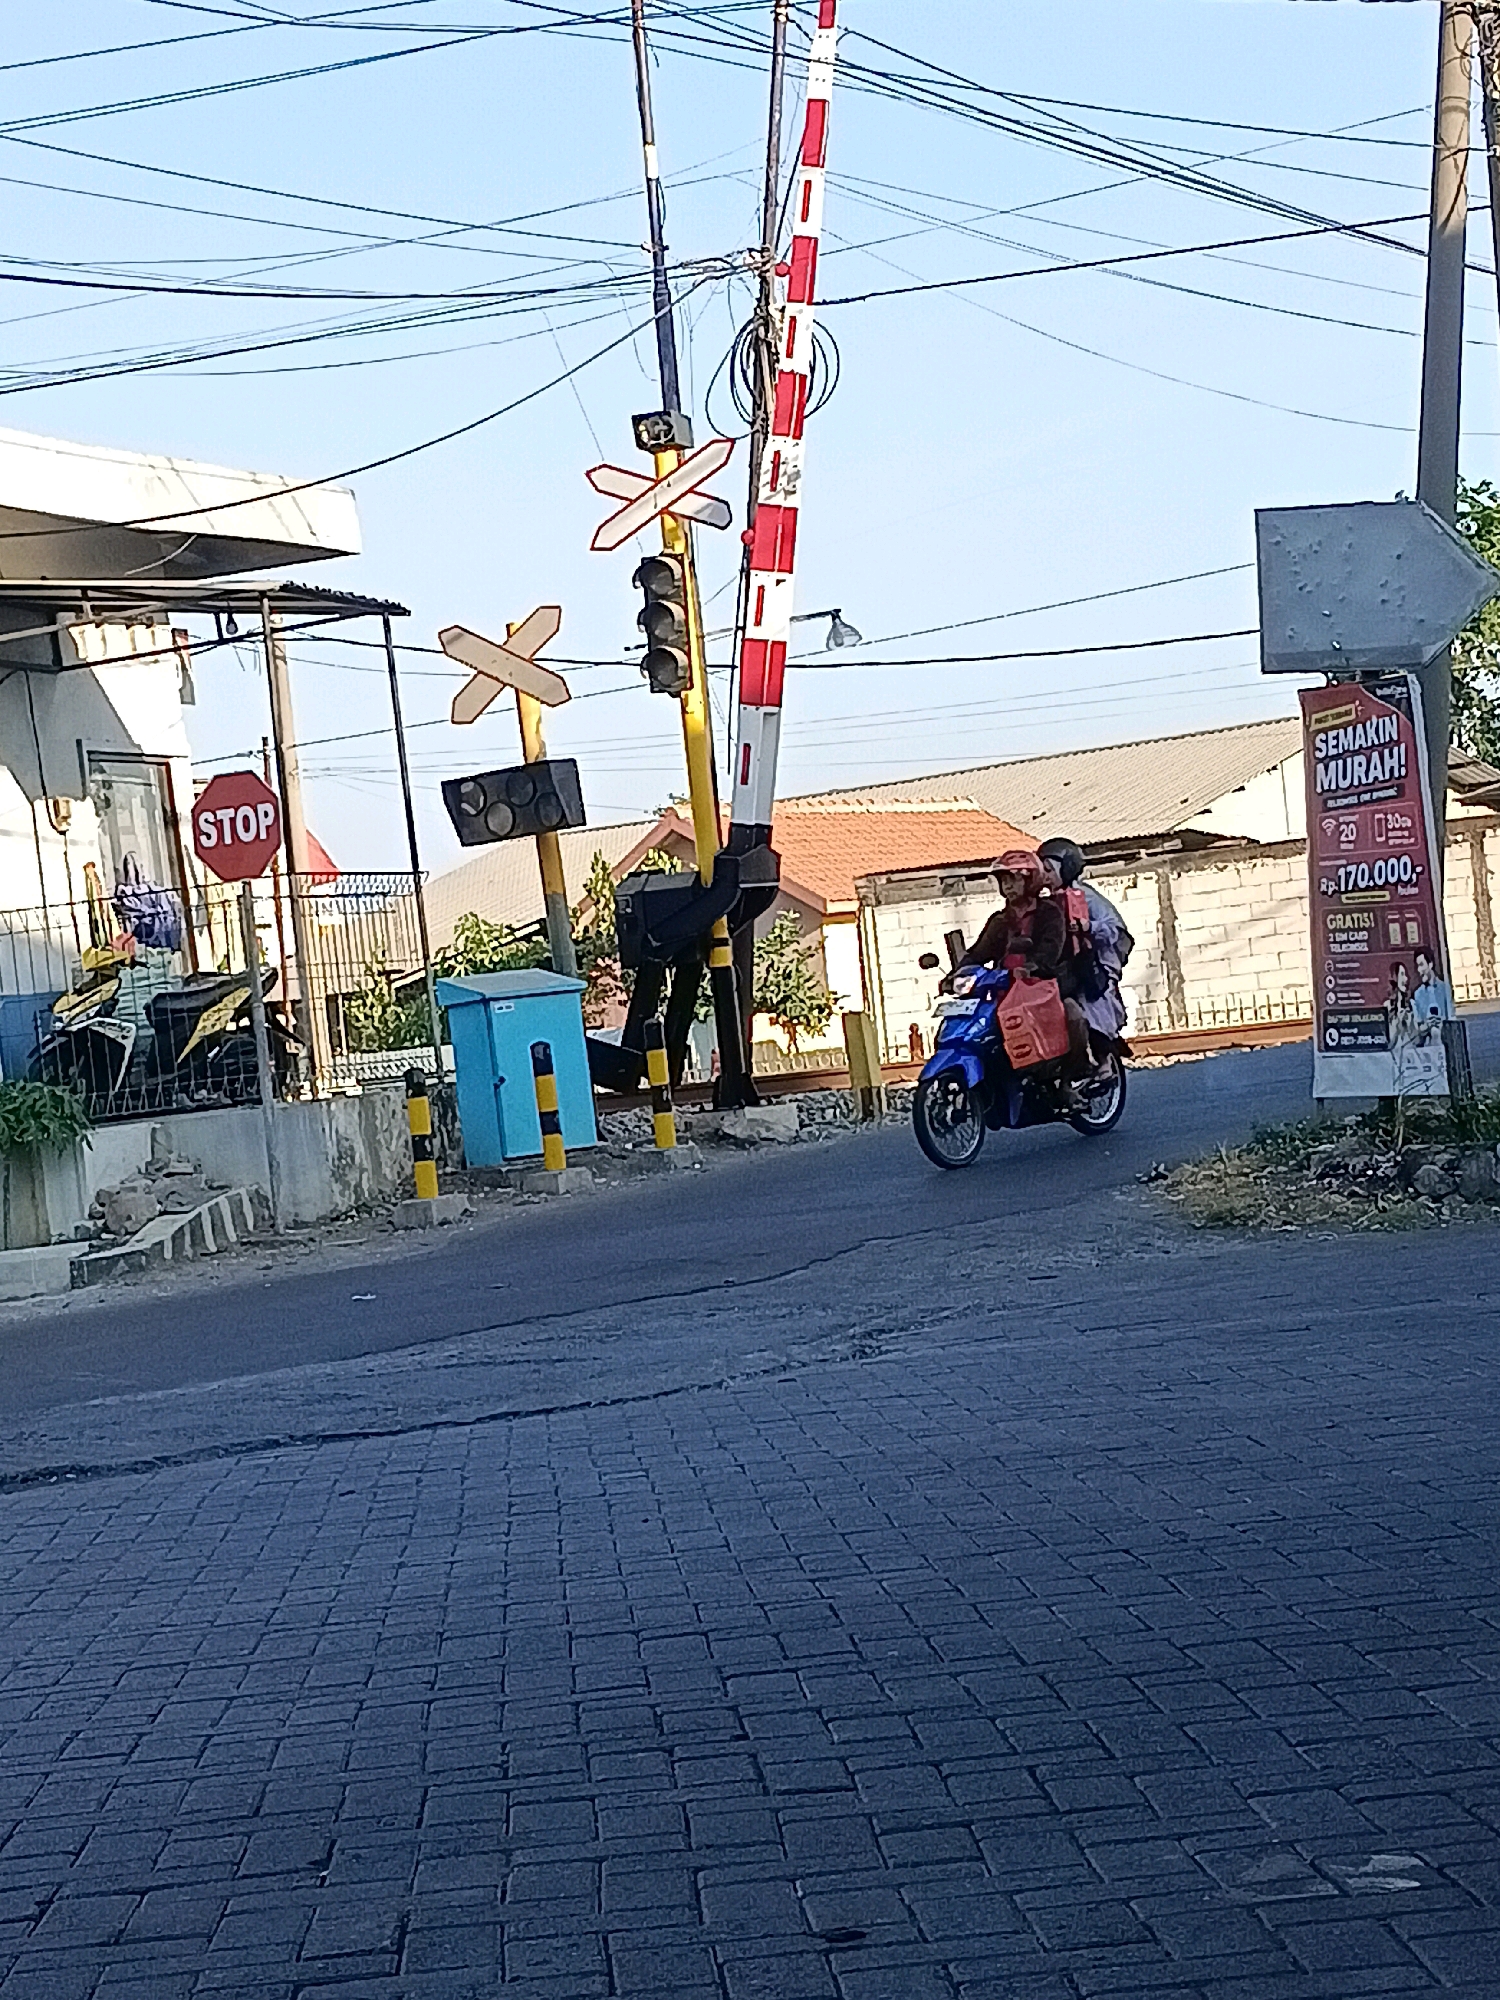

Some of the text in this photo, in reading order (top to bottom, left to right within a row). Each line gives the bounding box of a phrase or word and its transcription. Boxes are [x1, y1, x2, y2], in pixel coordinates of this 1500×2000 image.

[1314, 713, 1398, 759] SEMAKIN
[1316, 742, 1406, 794] MURAH!
[198, 802, 275, 848] STOP
[1339, 823, 1357, 842] 20
[1326, 912, 1375, 930] GRATIS!
